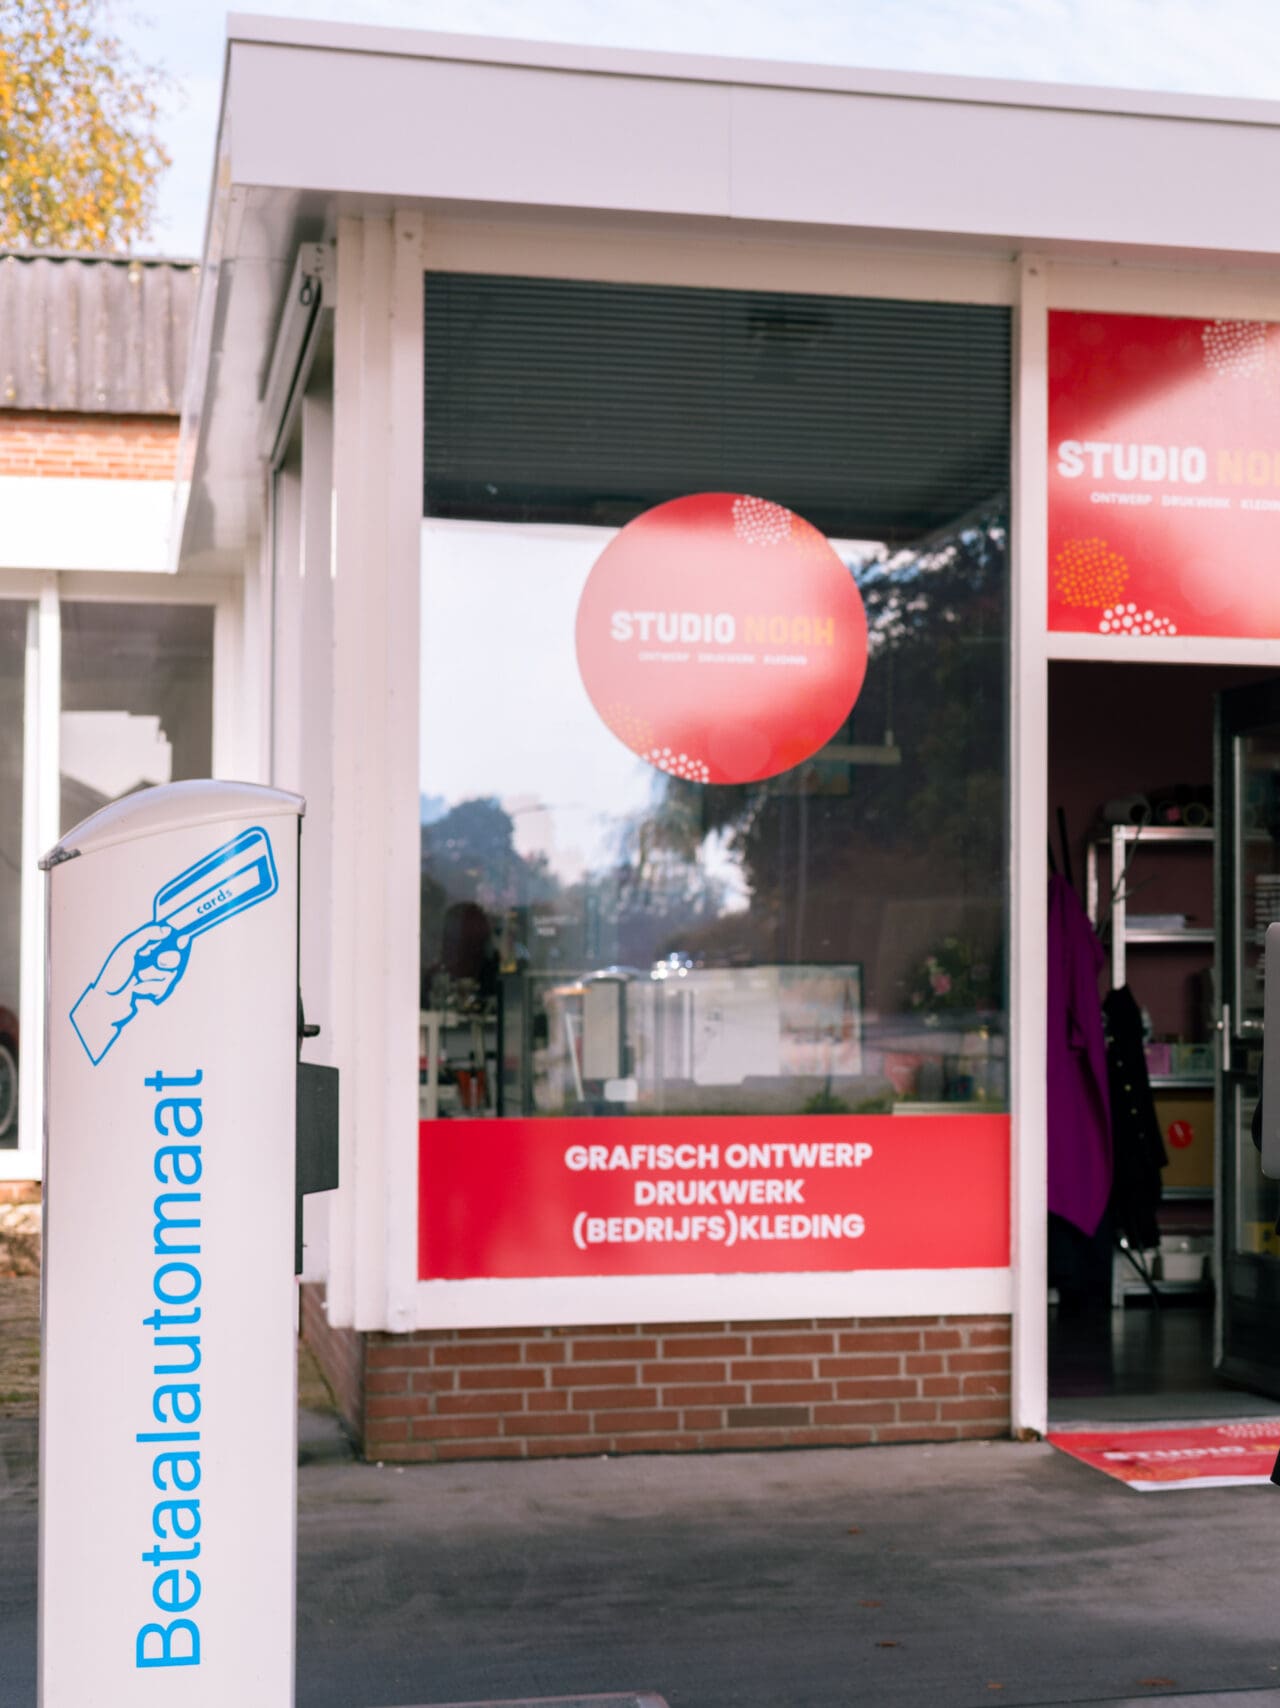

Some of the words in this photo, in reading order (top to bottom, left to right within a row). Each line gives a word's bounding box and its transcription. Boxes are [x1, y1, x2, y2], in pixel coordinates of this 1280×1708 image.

[1057, 440, 1207, 484] STUDIO
[610, 610, 736, 644] STUDIO
[744, 615, 836, 647] NOAH
[196, 889, 233, 915] cards
[564, 1143, 719, 1172] GRAFISCH
[725, 1142, 873, 1170] ONTWERP
[634, 1178, 805, 1206] DRUKWERK
[573, 1211, 866, 1249] (BEDRIJFS)KLEDING
[136, 1068, 203, 1668] Betaalautomaat
